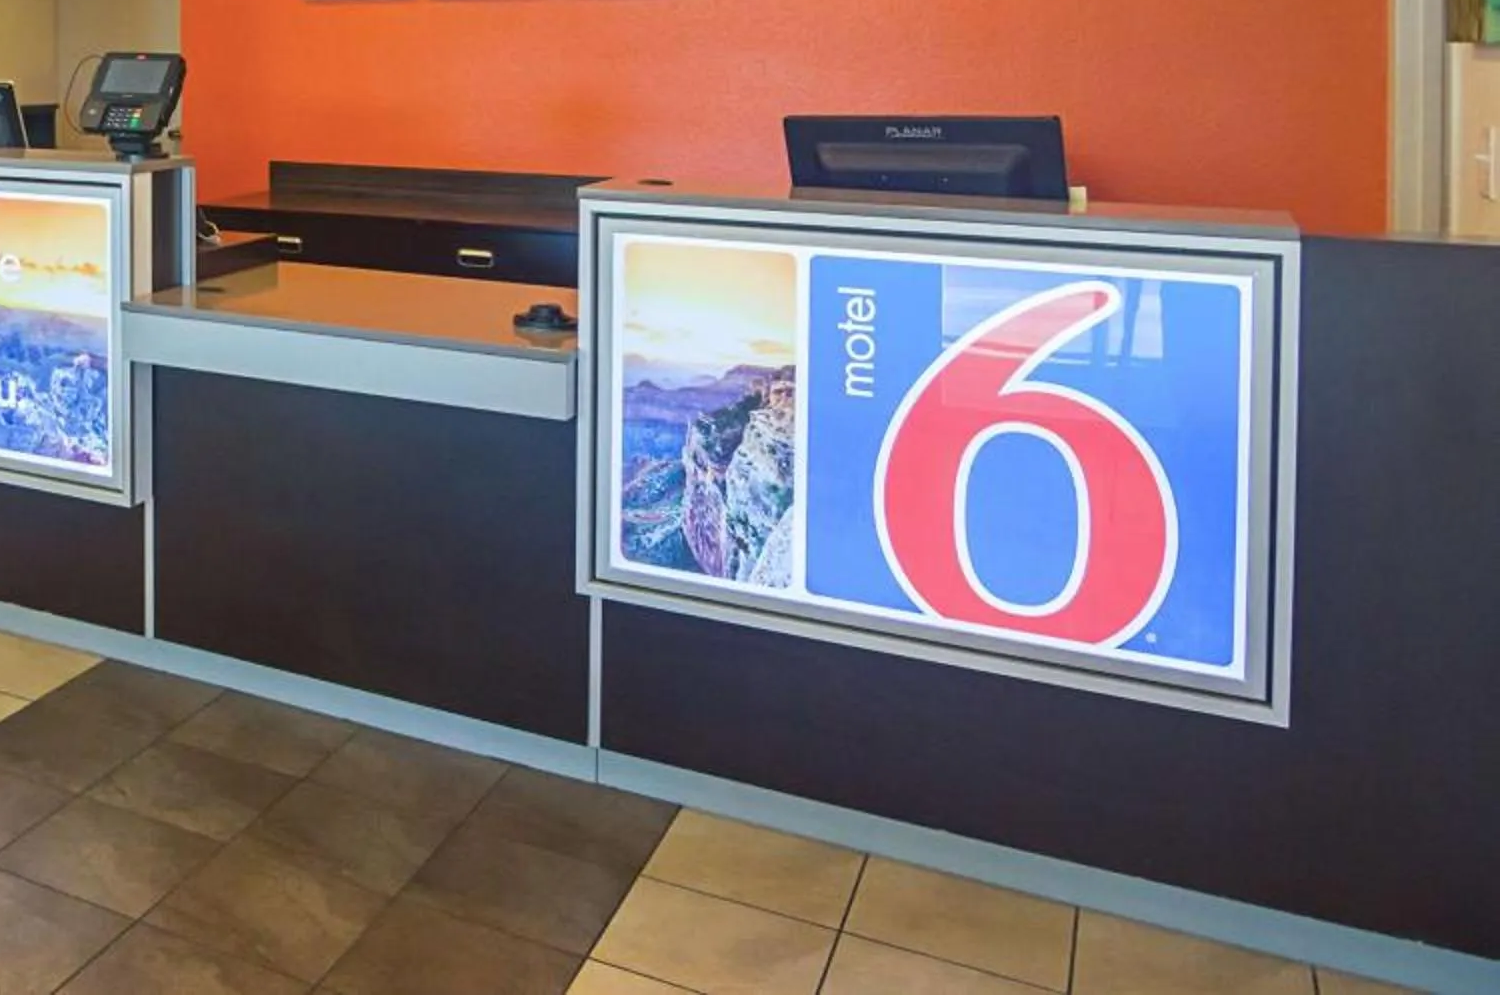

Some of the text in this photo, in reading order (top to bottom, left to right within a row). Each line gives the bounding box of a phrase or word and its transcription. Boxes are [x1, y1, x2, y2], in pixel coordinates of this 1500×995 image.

[885, 126, 943, 139] PLANAR
[837, 286, 877, 398] motel
[873, 280, 1179, 650] 6
